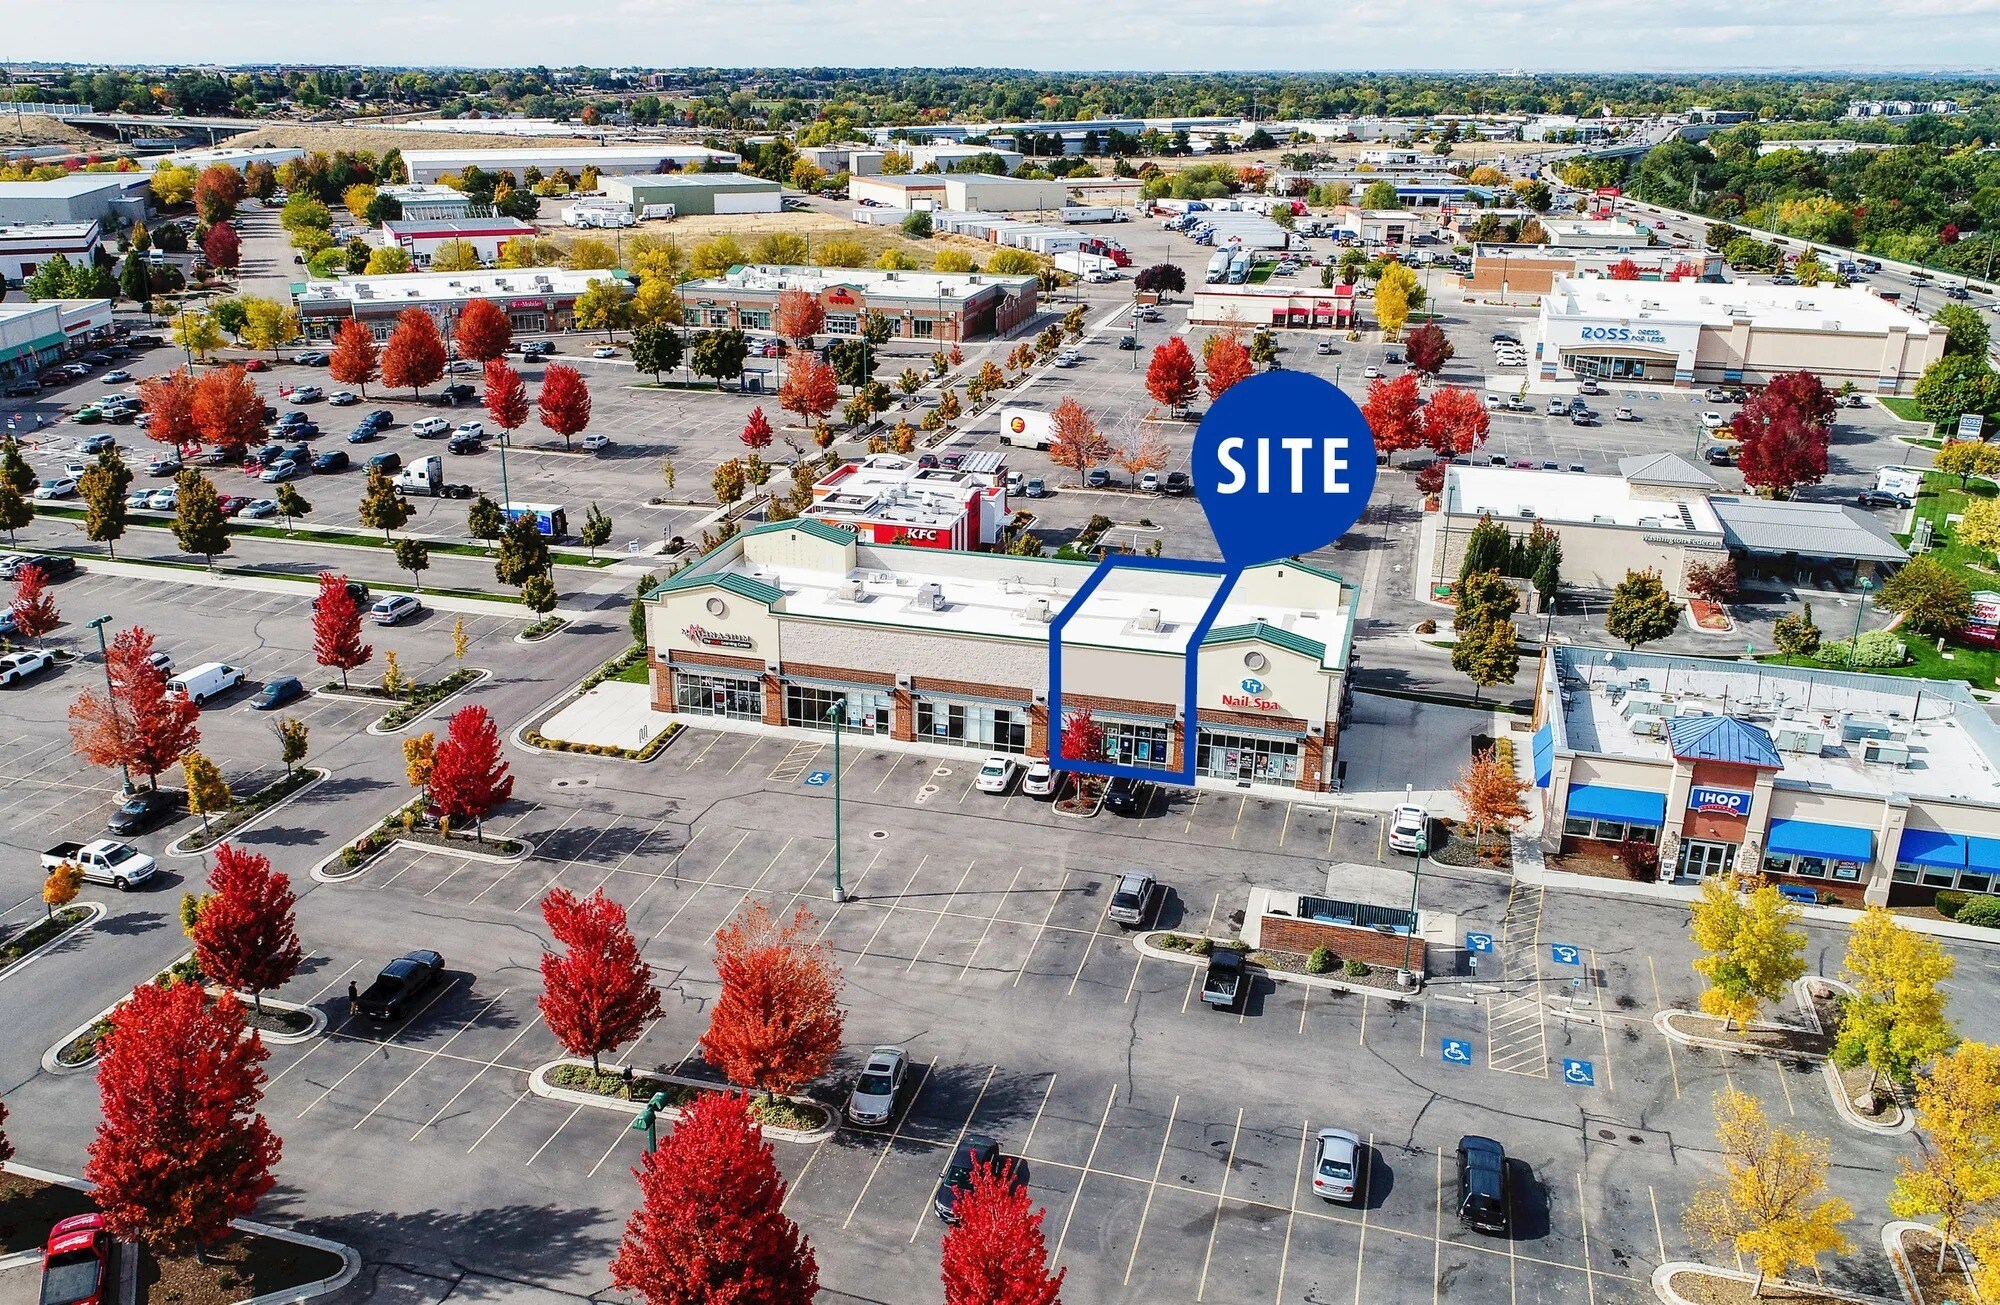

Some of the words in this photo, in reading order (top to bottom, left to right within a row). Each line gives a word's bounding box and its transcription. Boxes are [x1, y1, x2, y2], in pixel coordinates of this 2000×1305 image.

[1581, 326, 1630, 340] ROSS
[907, 528, 937, 540] KFC
[1641, 534, 1688, 545] Washington
[1976, 603, 1996, 612] Fred
[1222, 695, 1249, 706] Nail
[1253, 697, 1279, 711] Spa
[1699, 791, 1741, 808] IHOP
